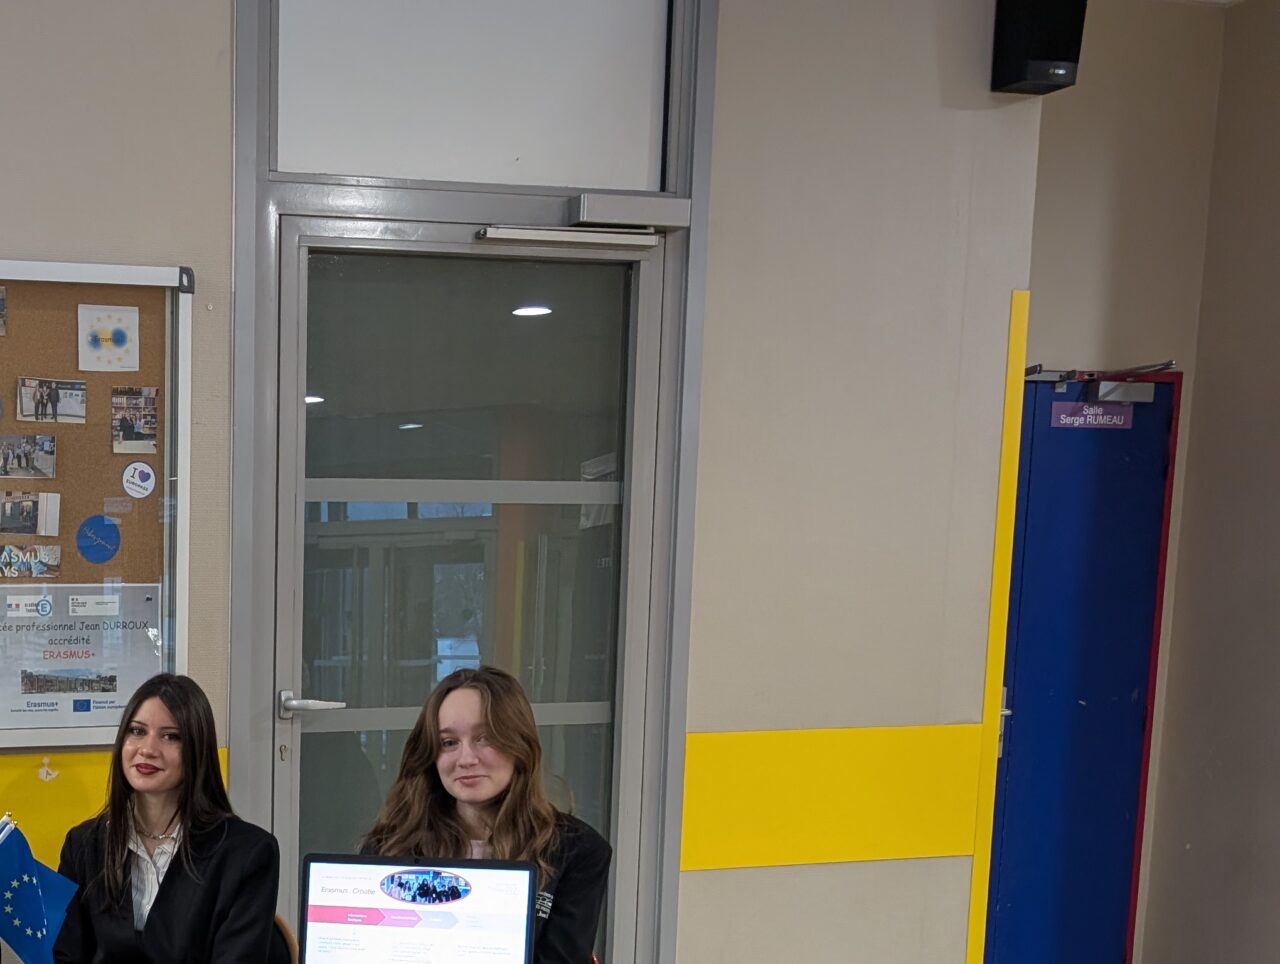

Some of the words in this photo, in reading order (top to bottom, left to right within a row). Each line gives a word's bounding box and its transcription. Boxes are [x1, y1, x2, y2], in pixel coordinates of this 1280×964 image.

[1082, 405, 1103, 415] Salle
[1059, 415, 1085, 427] Serge
[1086, 415, 1124, 425] RUMEAU
[130, 467, 138, 479] I
[15, 622, 77, 633] professionnel
[78, 622, 101, 632] Jean
[102, 621, 149, 631] DURROUX
[48, 636, 91, 646] accrédité
[42, 650, 96, 660] ERASMUS+
